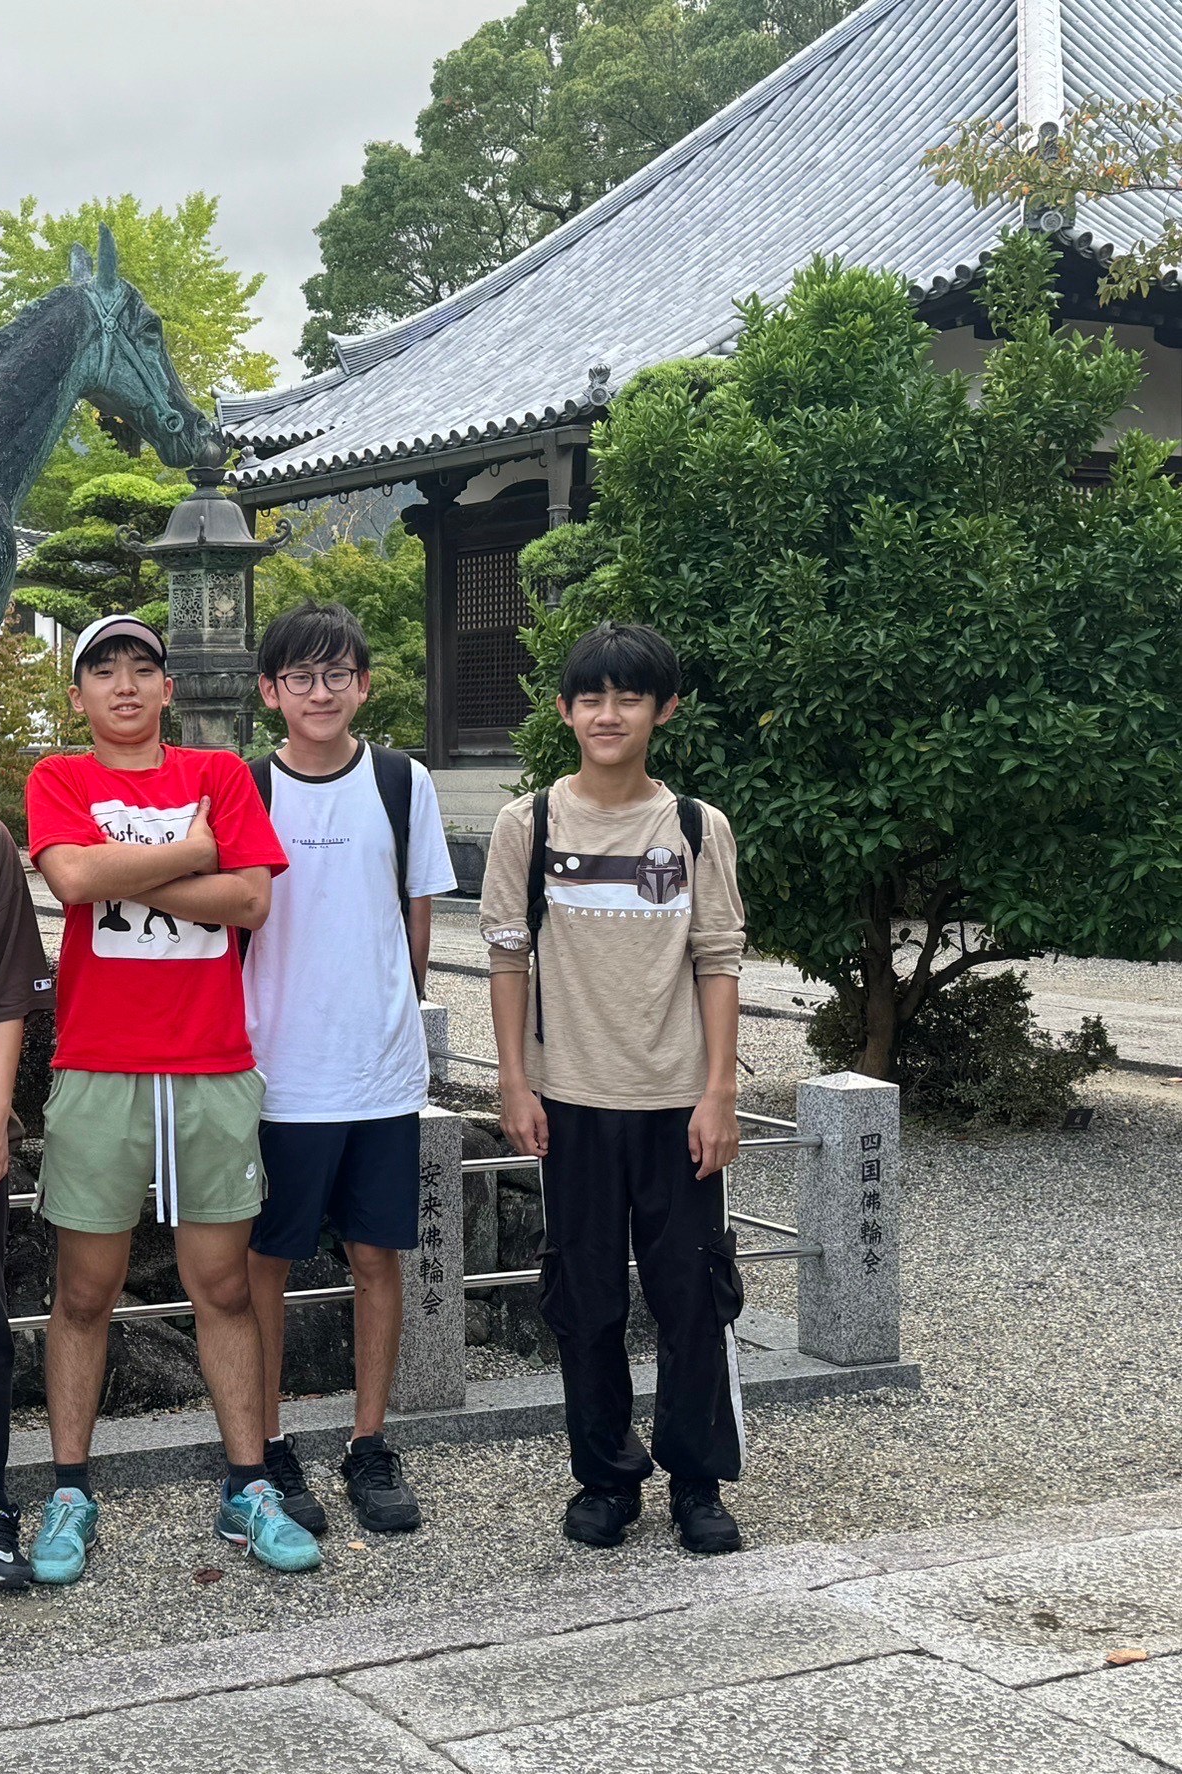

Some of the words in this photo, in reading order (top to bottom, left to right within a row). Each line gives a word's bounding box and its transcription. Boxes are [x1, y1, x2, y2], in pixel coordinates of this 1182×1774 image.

[100, 821, 152, 845] Justice
[568, 906, 692, 918] MANDALORIAN
[419, 1160, 444, 1316] 安来佛輪会
[860, 1133, 882, 1275] 四国佛輪会
